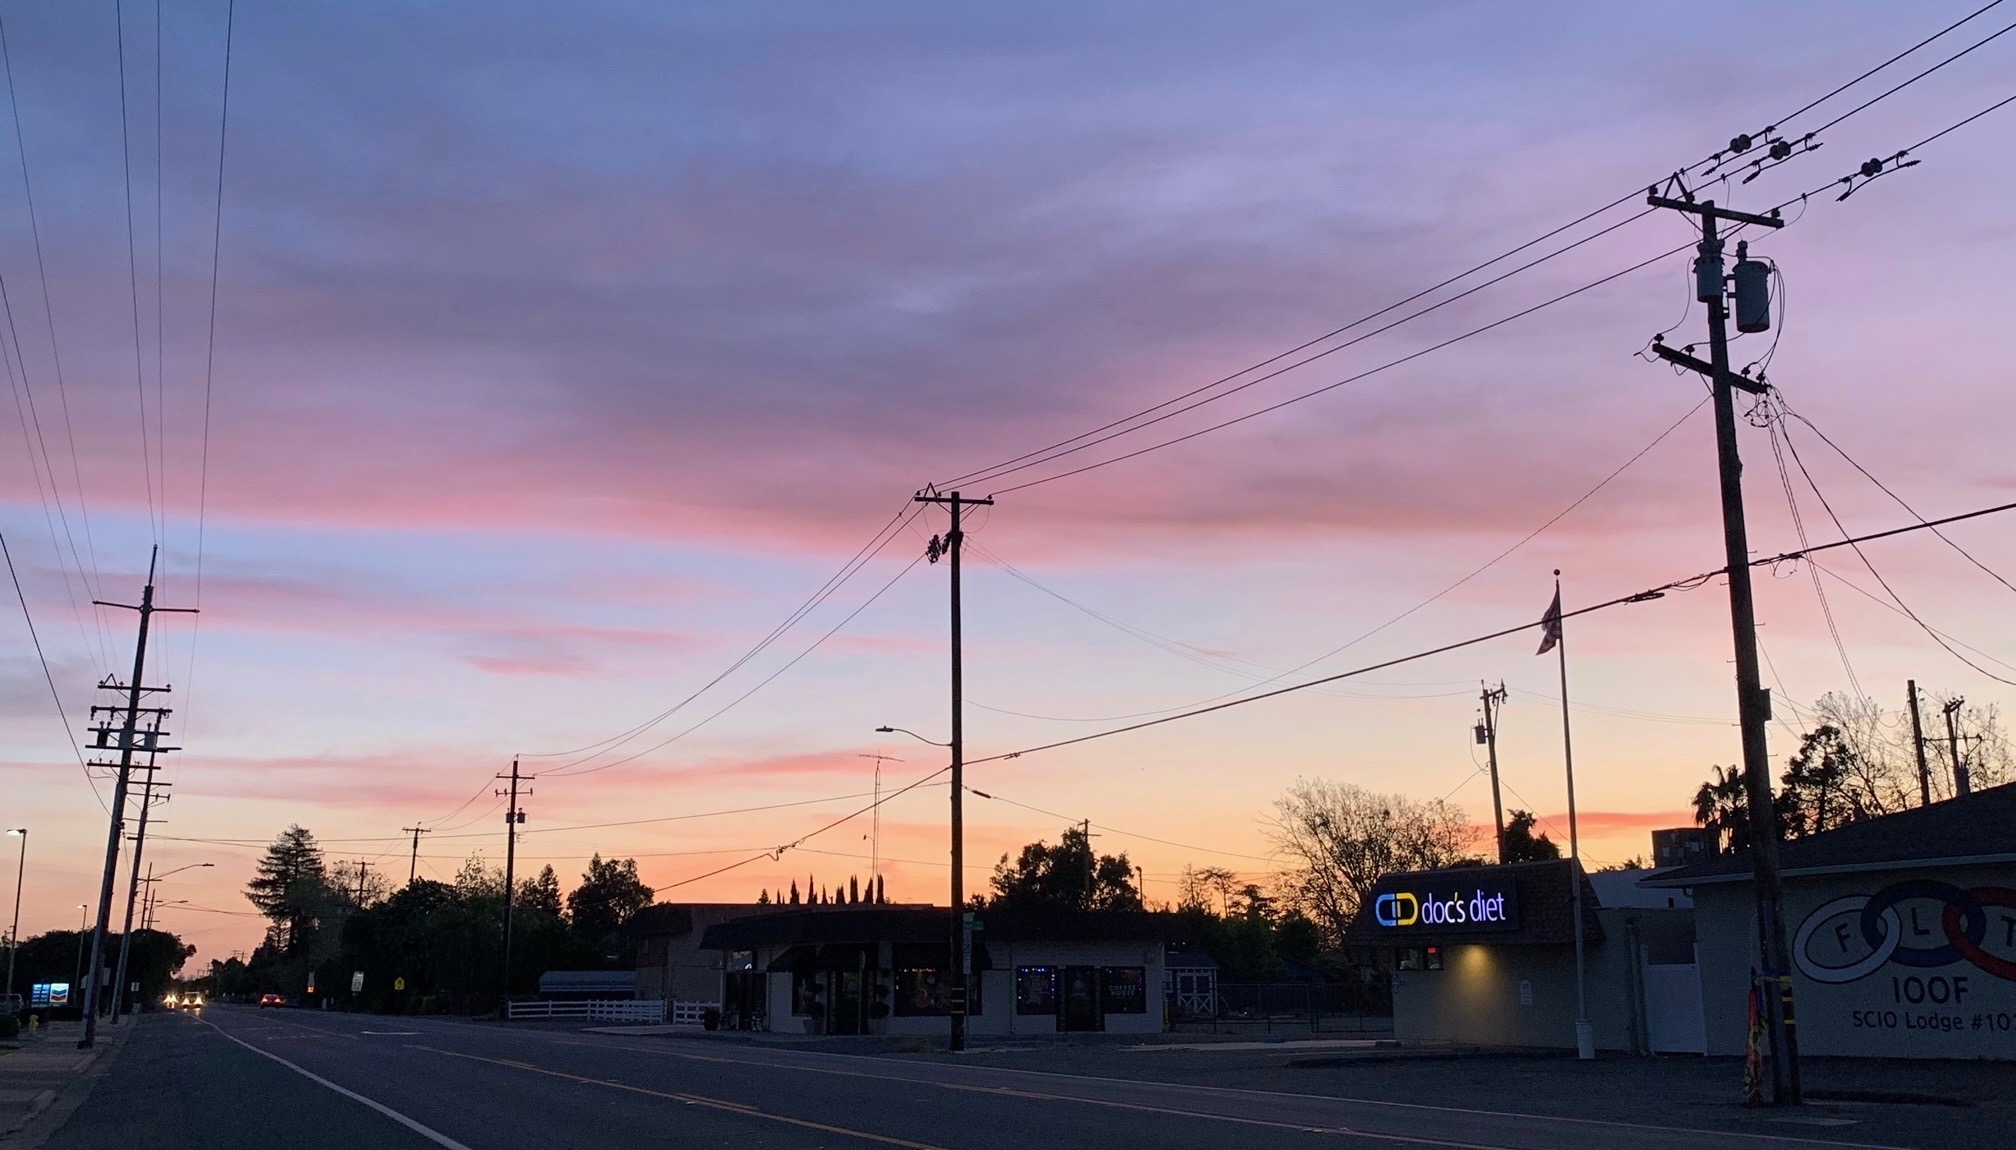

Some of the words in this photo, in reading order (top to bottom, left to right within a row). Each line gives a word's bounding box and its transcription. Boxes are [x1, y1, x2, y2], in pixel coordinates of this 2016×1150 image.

[1421, 891, 1466, 925] doc's
[1469, 889, 1506, 922] diet
[1834, 921, 1850, 953] F
[1910, 906, 1931, 936] L
[2000, 915, 2016, 947] T
[1852, 1010, 1897, 1029] SCIO
[1905, 1011, 1964, 1032] Lodge
[1971, 1013, 2016, 1032] #10
